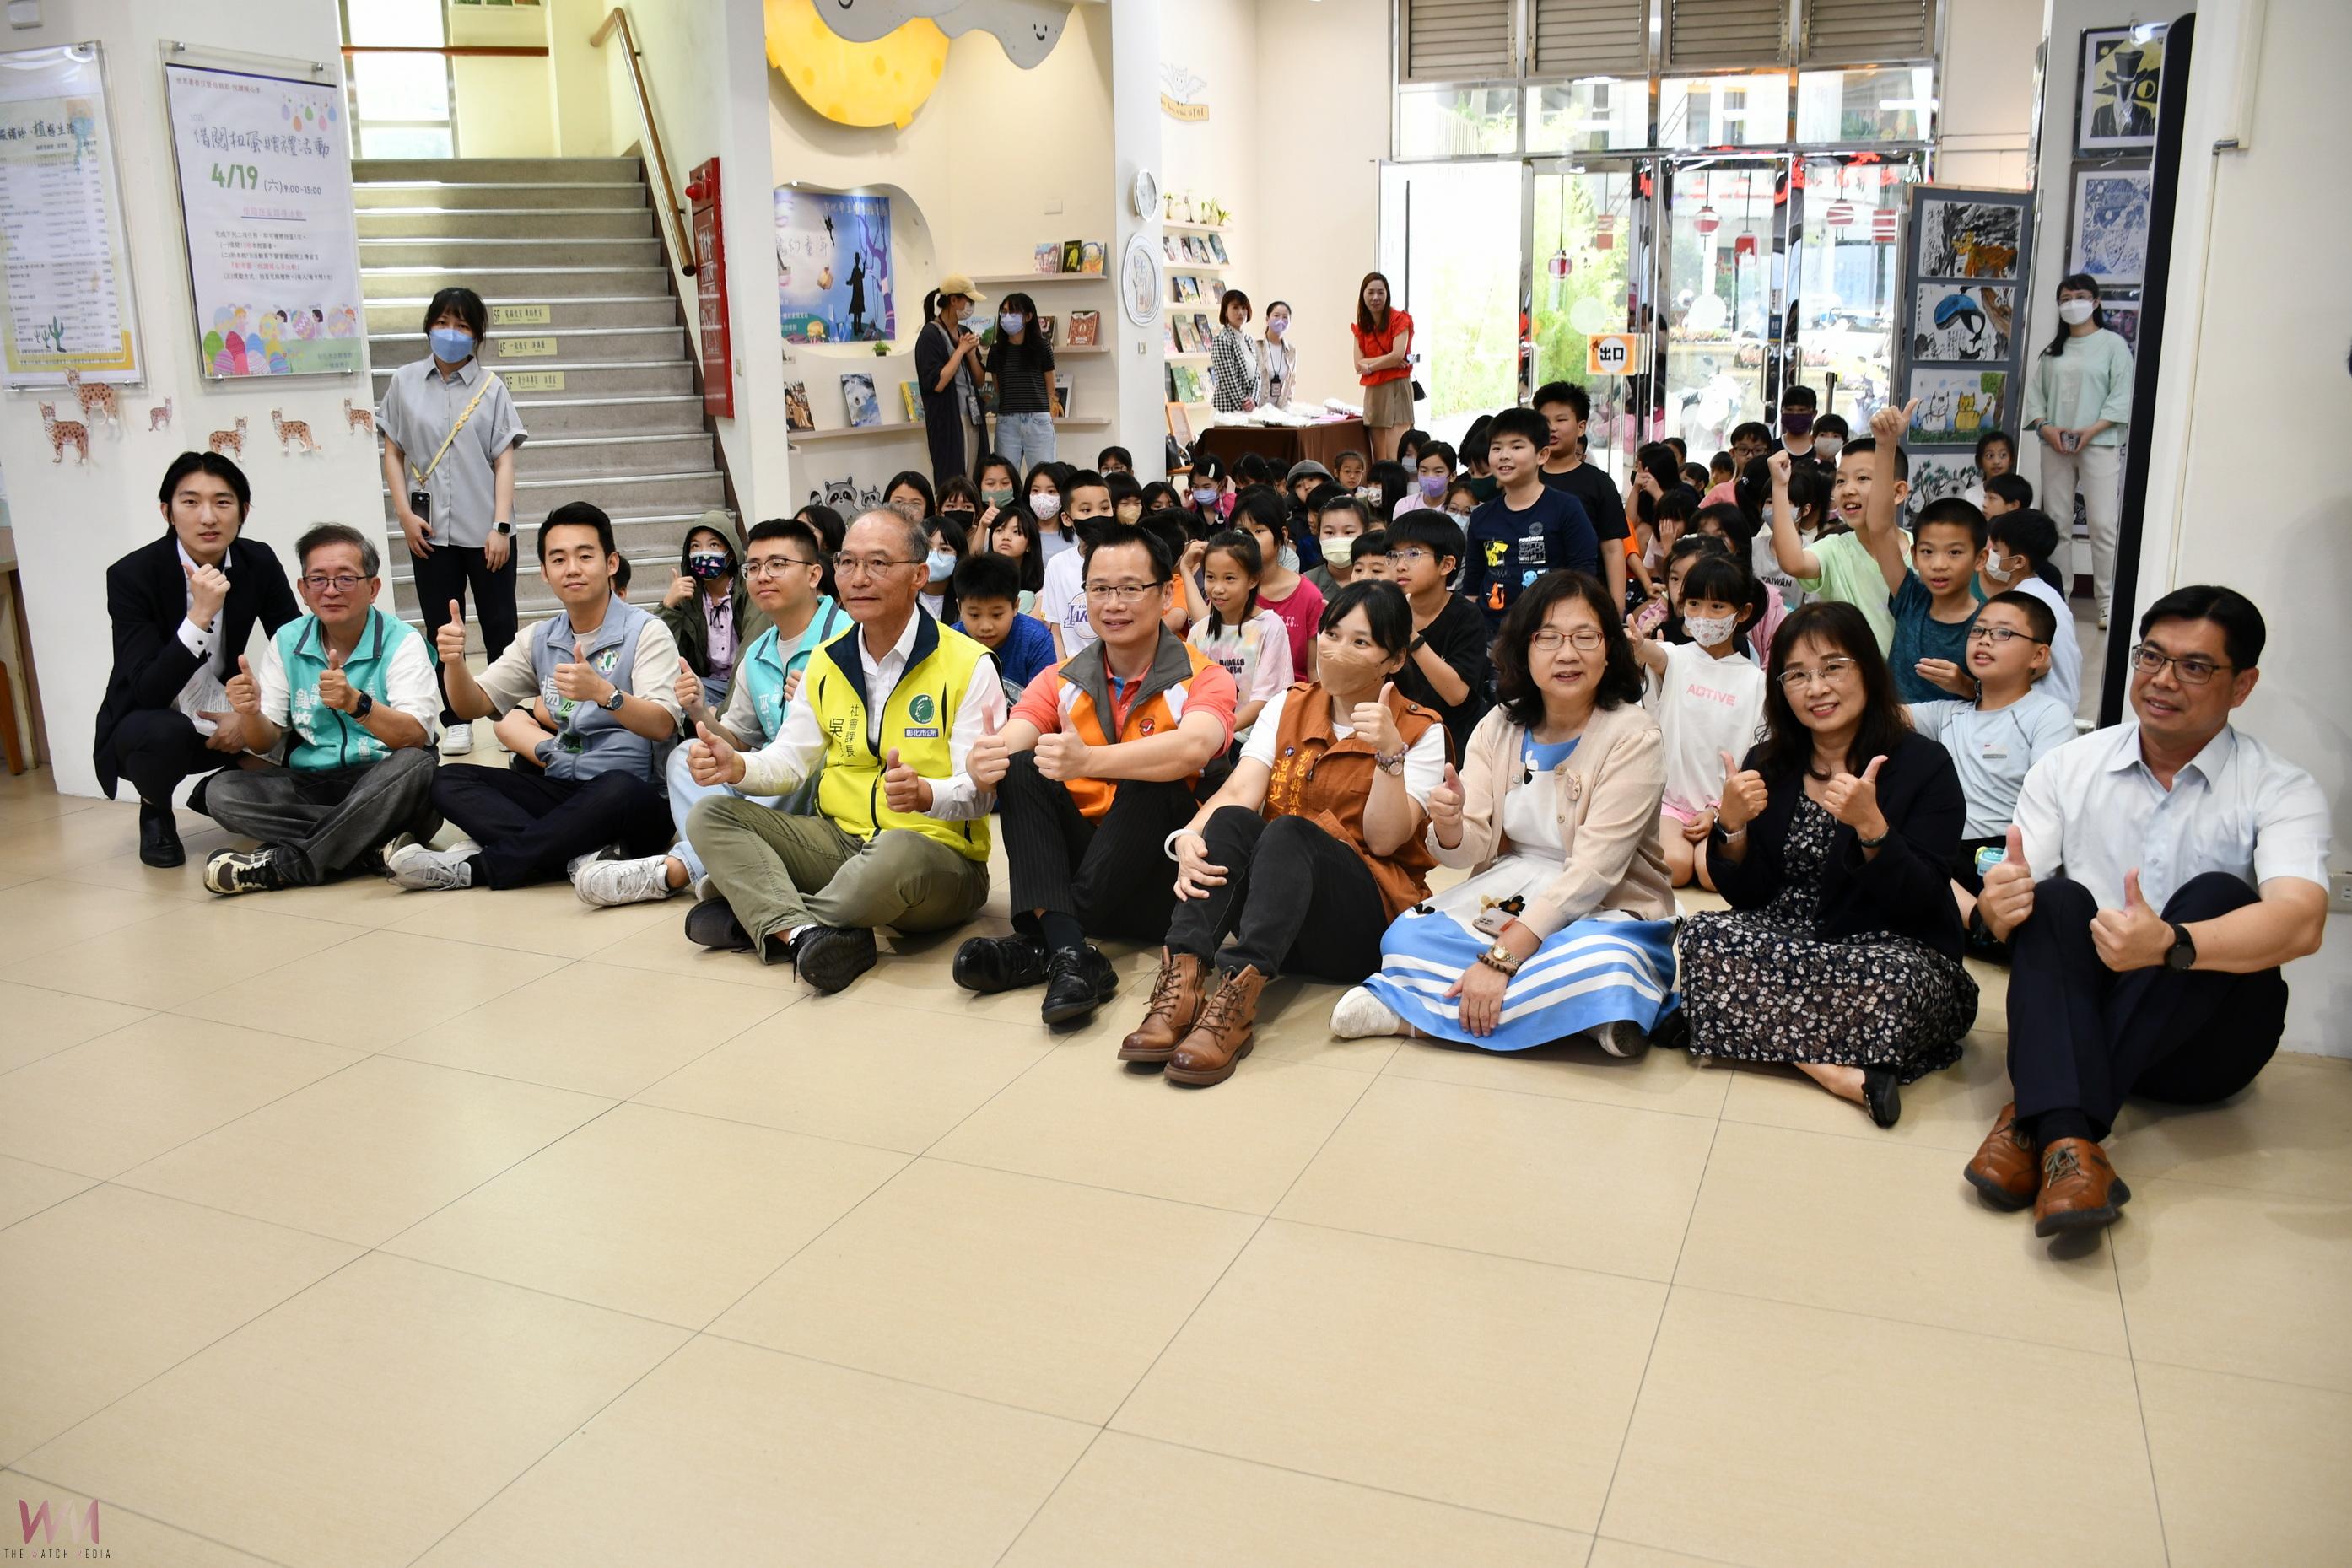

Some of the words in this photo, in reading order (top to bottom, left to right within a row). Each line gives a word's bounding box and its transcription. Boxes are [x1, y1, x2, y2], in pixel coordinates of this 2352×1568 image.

[212, 163, 258, 190] 4/19
[494, 309, 500, 322] 5F
[499, 341, 506, 355] 4F
[1599, 346, 1624, 361] 出口
[1761, 576, 1793, 587] TAIWAN
[1686, 683, 1736, 707] ACTIVE
[844, 704, 860, 757] 社會課長
